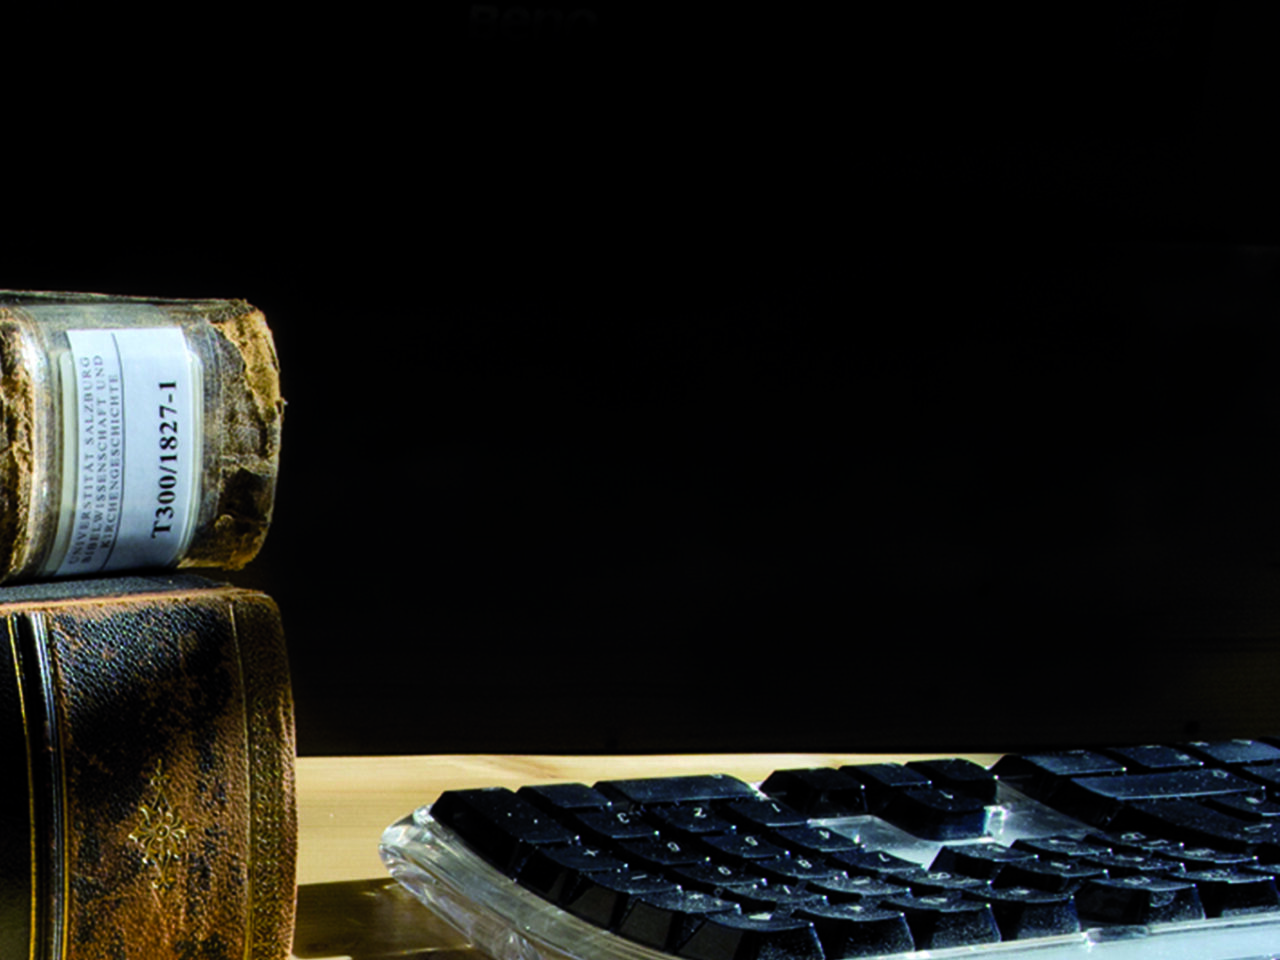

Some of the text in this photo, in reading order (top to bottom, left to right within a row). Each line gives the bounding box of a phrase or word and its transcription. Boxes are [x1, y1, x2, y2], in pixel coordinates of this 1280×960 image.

[79, 356, 96, 445] SALZBURG
[81, 354, 108, 564] BIBELWISSENSCHAFT UND
[100, 374, 120, 549] KIRCHENGESCHICHTE
[151, 381, 179, 539] T300/1827-1
